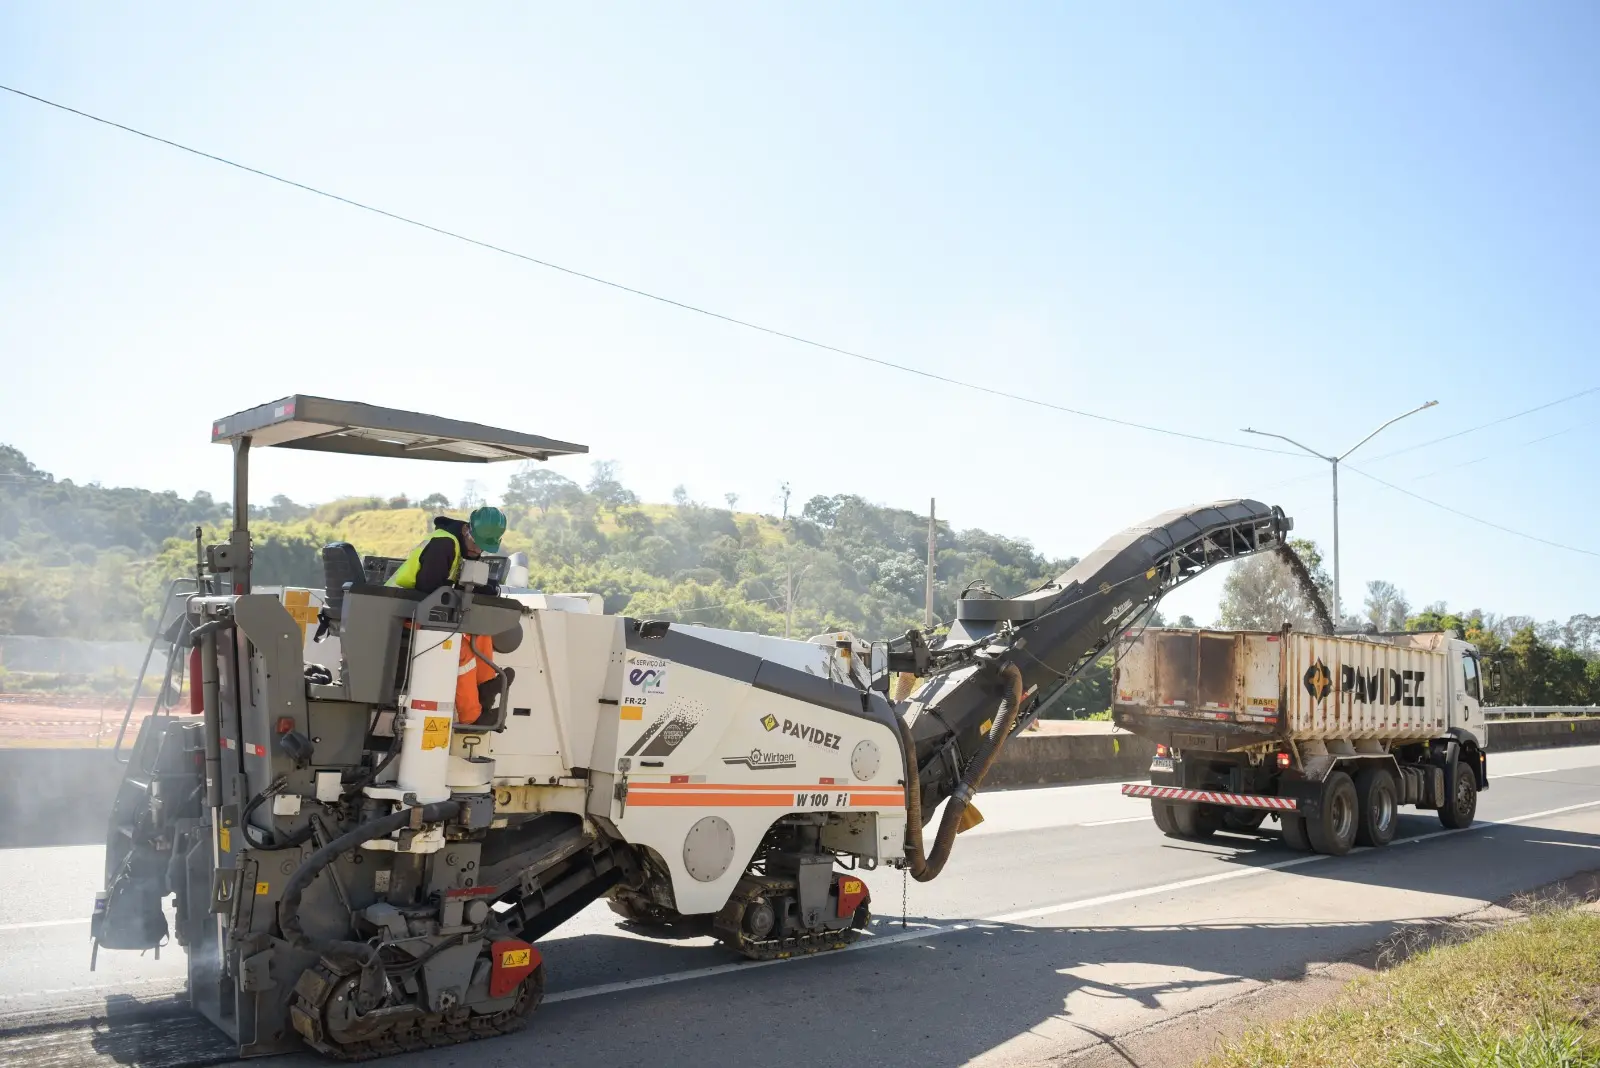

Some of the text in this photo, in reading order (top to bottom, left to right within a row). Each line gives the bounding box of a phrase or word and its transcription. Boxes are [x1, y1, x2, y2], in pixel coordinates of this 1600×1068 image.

[1342, 664, 1425, 707] PAVIDEZ
[624, 697, 647, 705] FR-22
[782, 719, 842, 750] PAVIDEZ
[763, 753, 794, 763] Wirtgen
[797, 793, 848, 807] W 100 Fi
